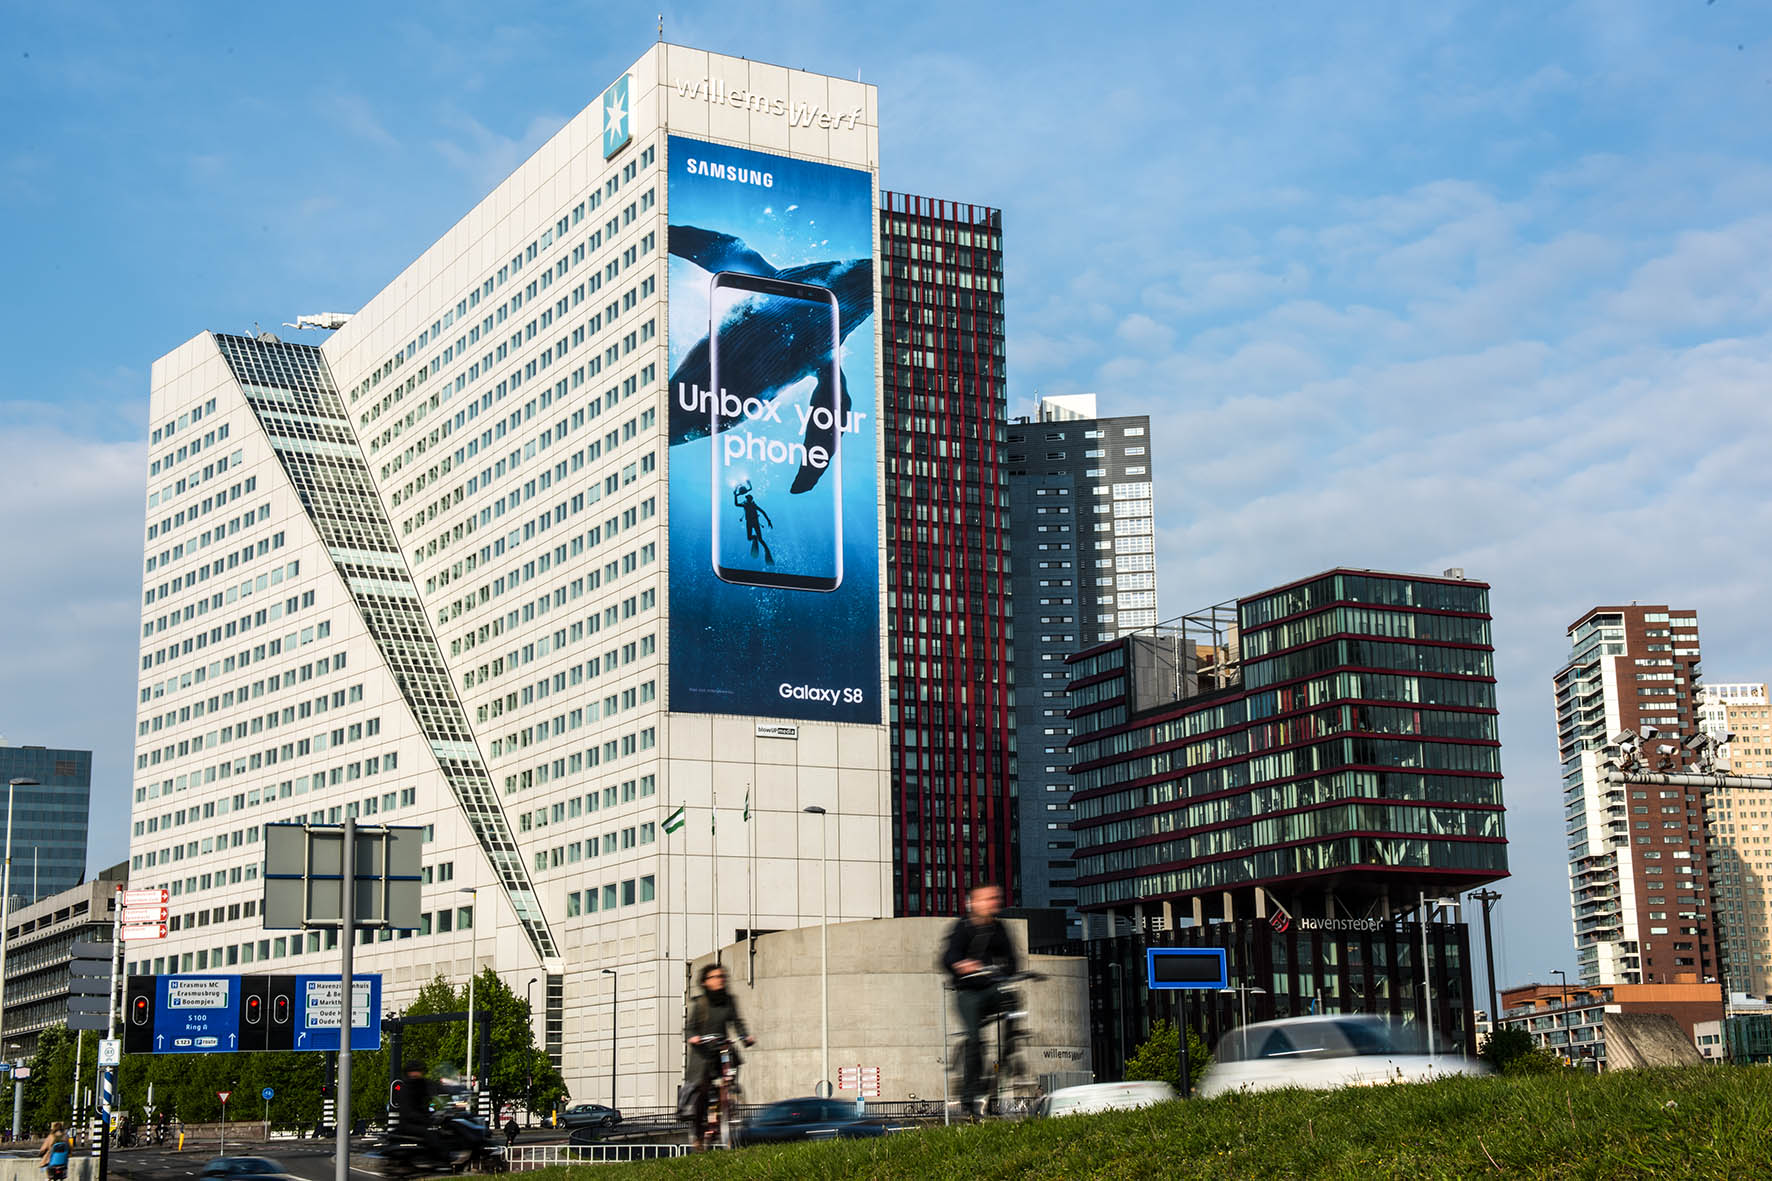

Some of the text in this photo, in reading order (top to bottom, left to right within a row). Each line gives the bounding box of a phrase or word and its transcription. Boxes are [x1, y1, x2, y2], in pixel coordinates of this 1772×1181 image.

[687, 158, 773, 188] SAMSUNG
[678, 382, 867, 436] Unbox your
[724, 432, 829, 469] phone
[779, 682, 863, 706] Galaxy S8
